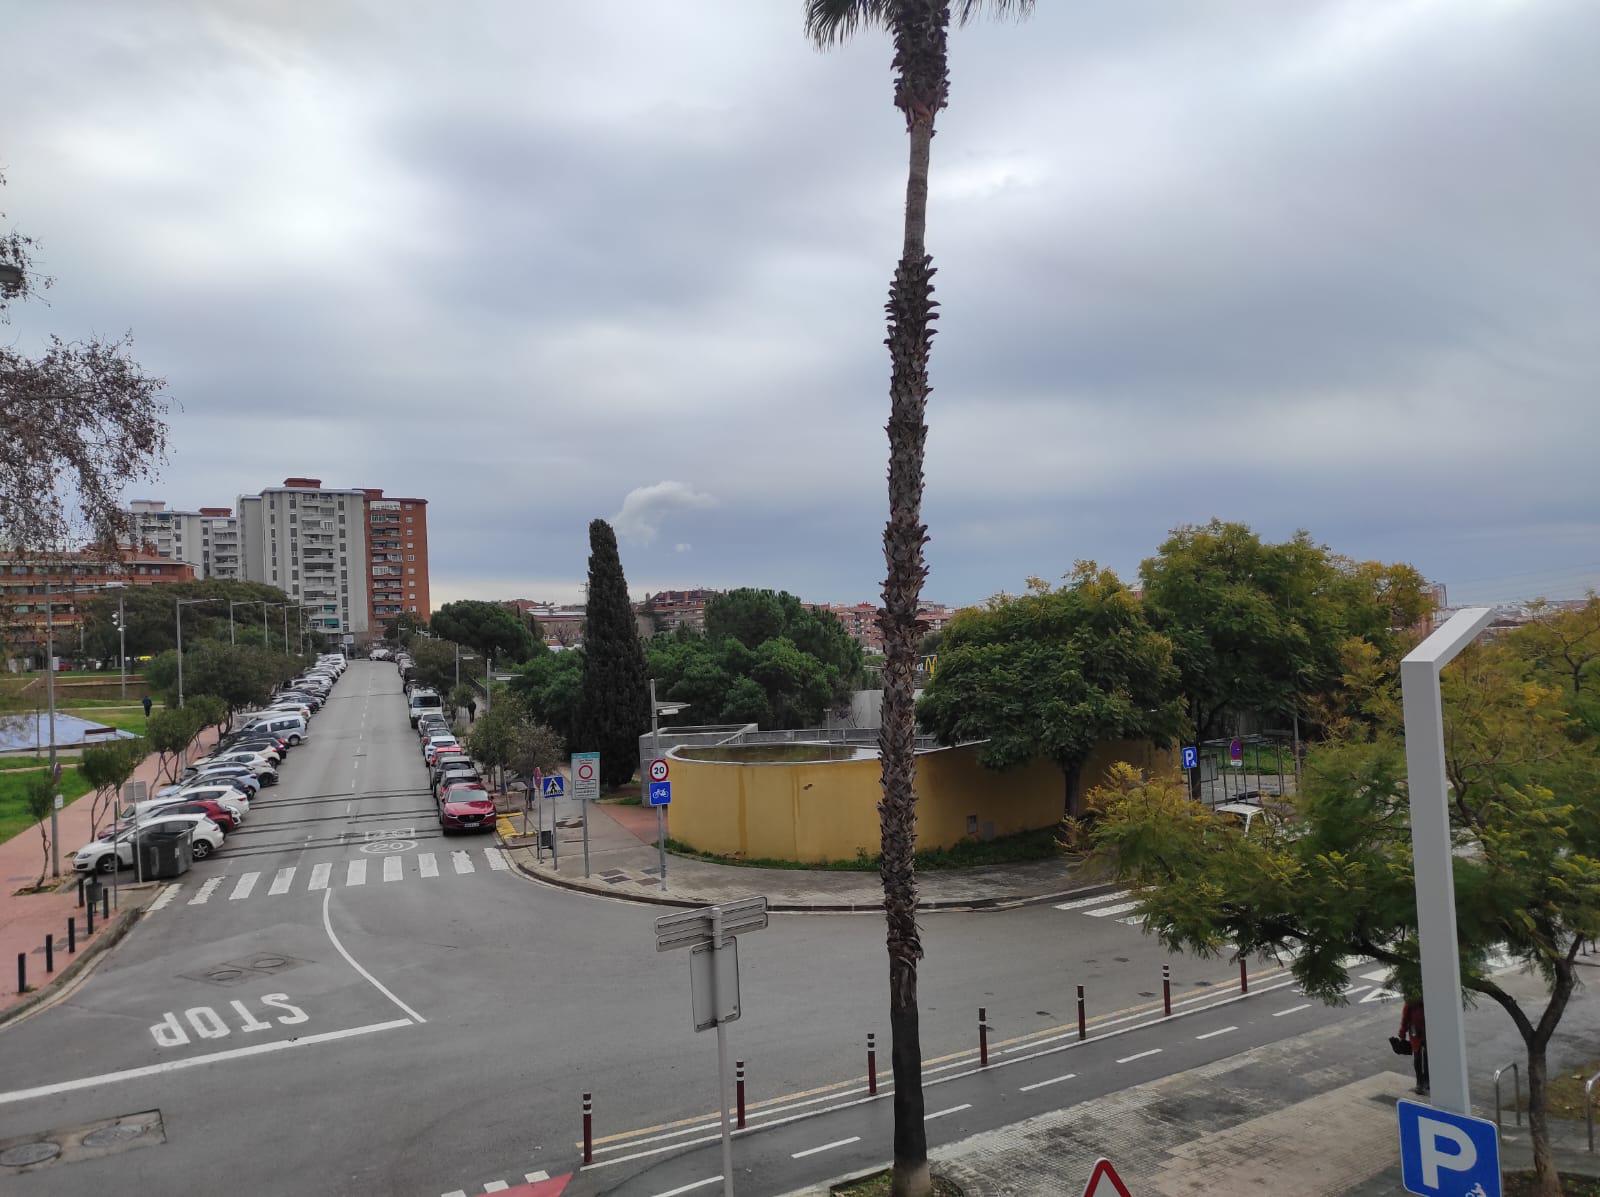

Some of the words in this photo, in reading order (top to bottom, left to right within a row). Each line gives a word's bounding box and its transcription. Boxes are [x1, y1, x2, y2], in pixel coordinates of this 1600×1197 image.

[653, 766, 665, 775] 20
[1185, 750, 1194, 766] P
[149, 992, 309, 1047] STOP
[1417, 1115, 1477, 1190] P
